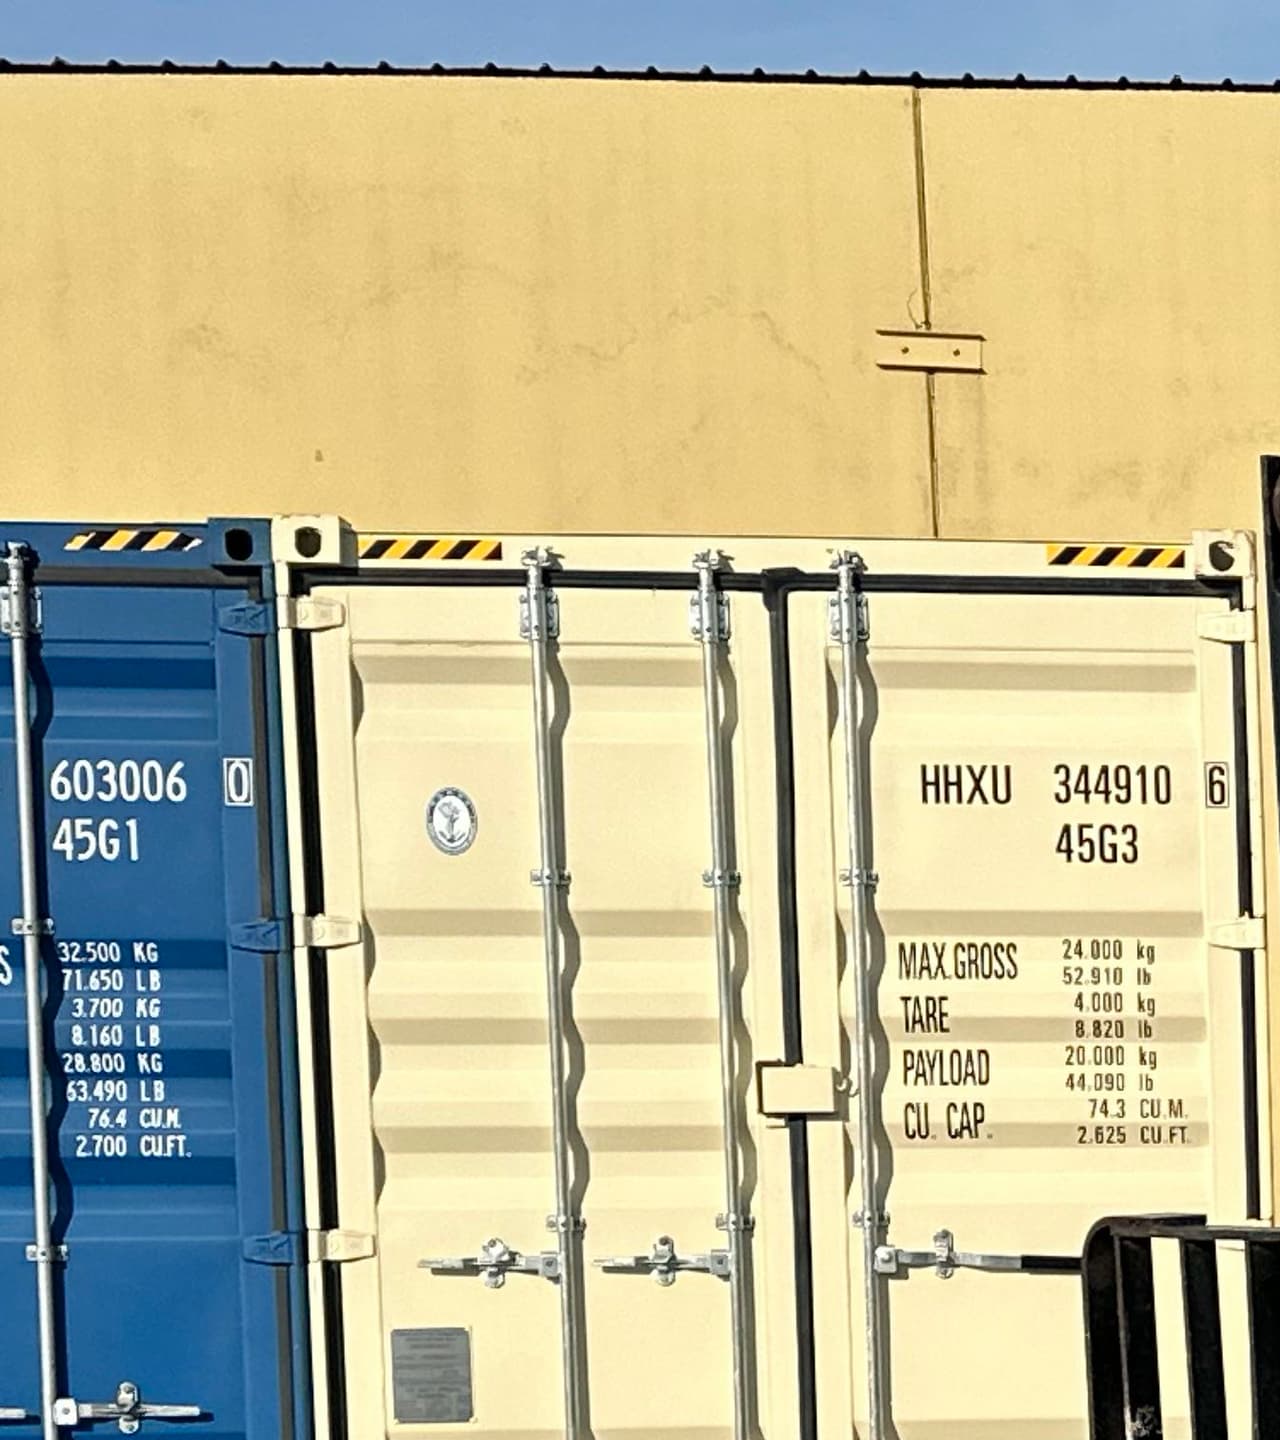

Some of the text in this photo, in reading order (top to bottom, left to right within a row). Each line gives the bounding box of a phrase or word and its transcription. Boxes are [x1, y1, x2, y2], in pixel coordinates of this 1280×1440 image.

[49, 759, 251, 804] 603006 0
[920, 763, 1227, 805] HHXU 344910 6
[52, 819, 140, 862] 45G1
[1055, 823, 1140, 864] 45G3
[57, 942, 159, 963] 32.500 KG
[1136, 939, 1155, 965] kg
[61, 969, 161, 992] 71.650 LB
[1136, 966, 1152, 985] lb
[72, 998, 161, 1018] 3.700 KG
[899, 996, 950, 1033] TARE
[1137, 991, 1155, 1017] kg
[71, 1024, 161, 1047] 8.160 LB
[1138, 1019, 1152, 1039] lb
[138, 1053, 164, 1073] KG
[903, 1049, 990, 1087] PAYLOAD
[1139, 1046, 1157, 1070] kg
[140, 1079, 165, 1102] LB
[1139, 1073, 1153, 1092] lb
[88, 1108, 127, 1129] 76.4
[75, 1135, 127, 1158] 2.700
